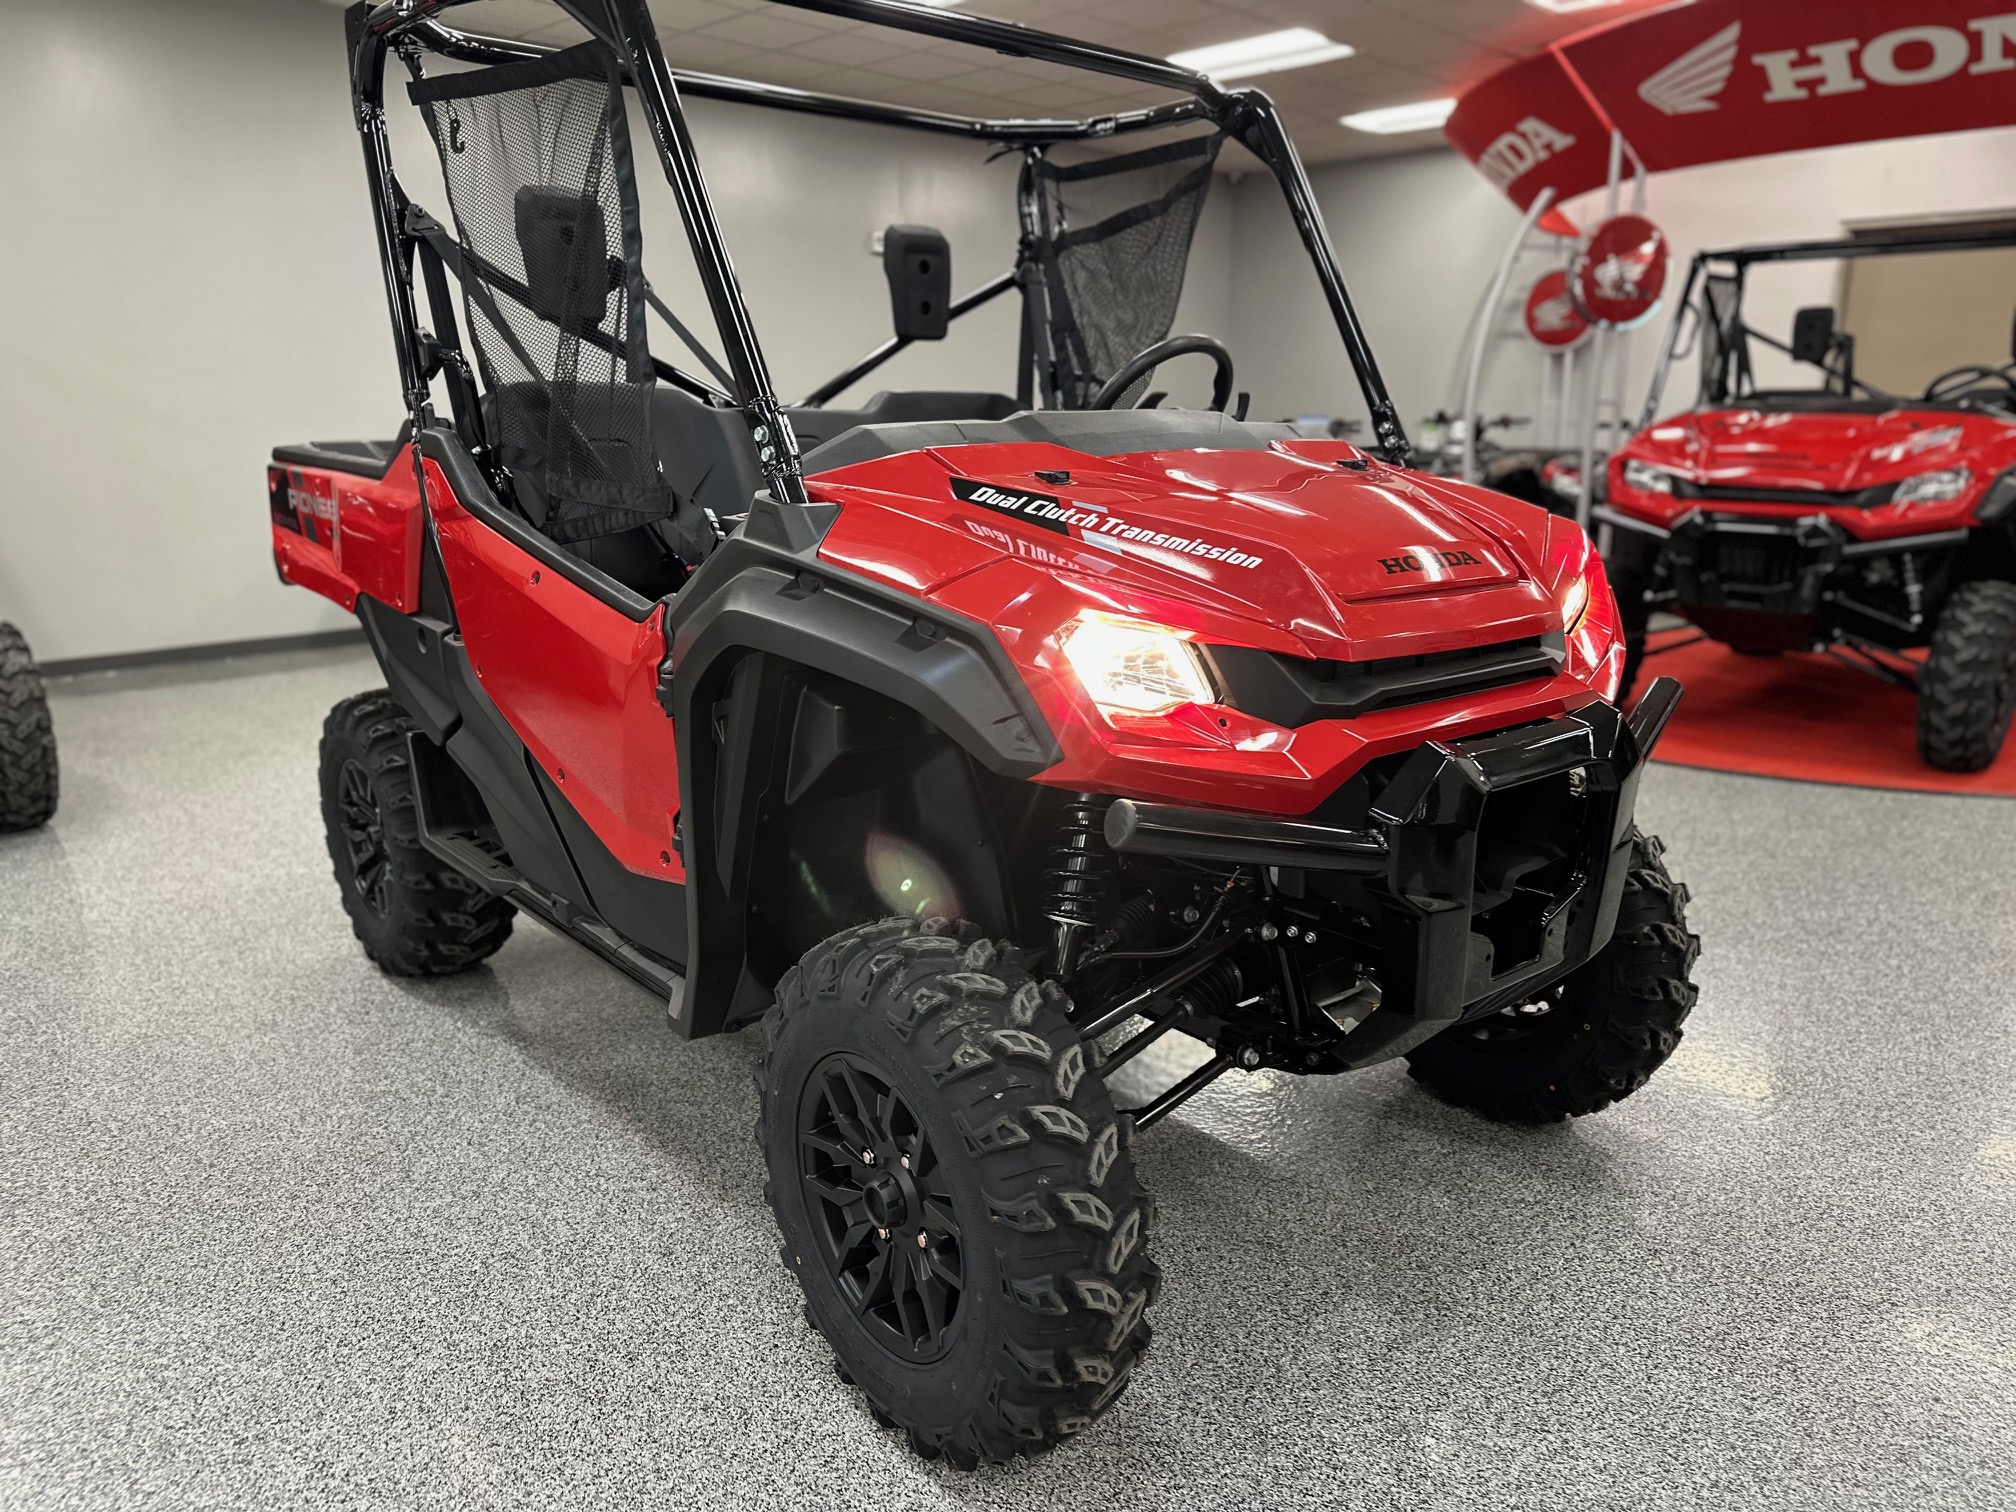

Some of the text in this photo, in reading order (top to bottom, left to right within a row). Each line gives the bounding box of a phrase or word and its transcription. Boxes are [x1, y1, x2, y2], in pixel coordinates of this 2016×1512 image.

[968, 486, 1264, 570] Dual Clutch Transmission
